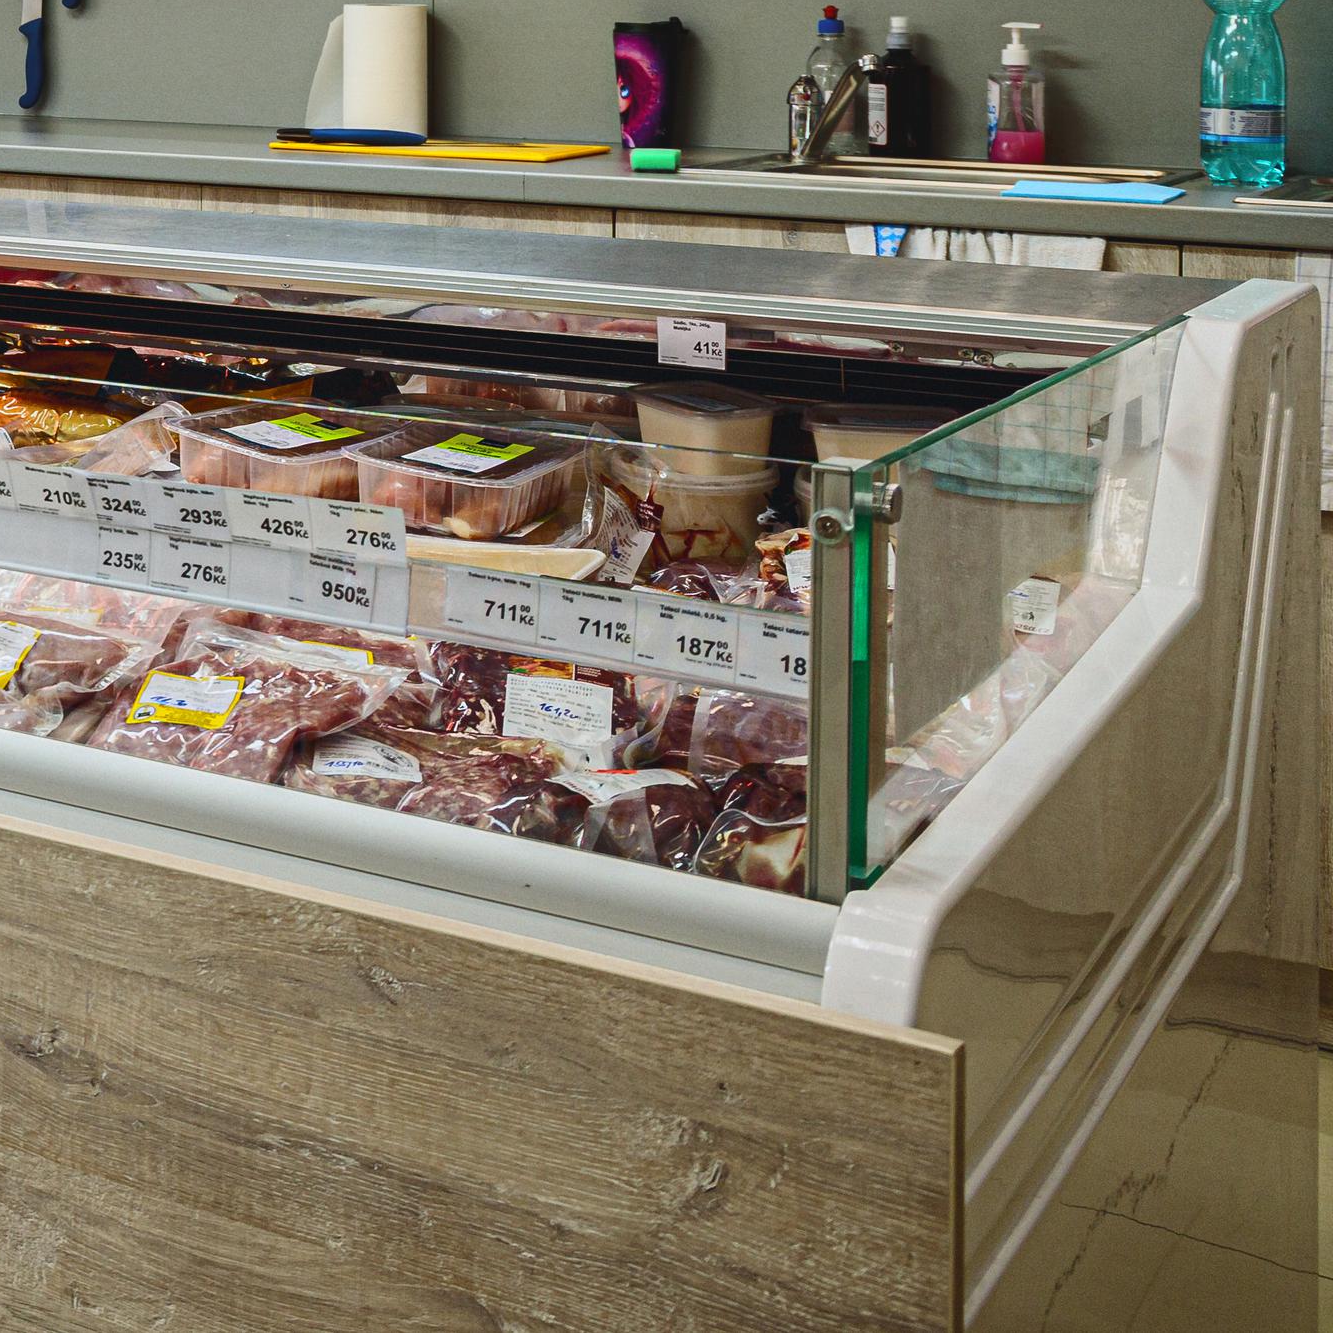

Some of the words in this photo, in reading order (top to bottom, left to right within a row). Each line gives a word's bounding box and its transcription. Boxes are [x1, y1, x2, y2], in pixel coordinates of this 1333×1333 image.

[694, 341, 710, 354] 41
[484, 600, 518, 622] 711
[578, 617, 613, 640] 711
[676, 635, 715, 658] 187
